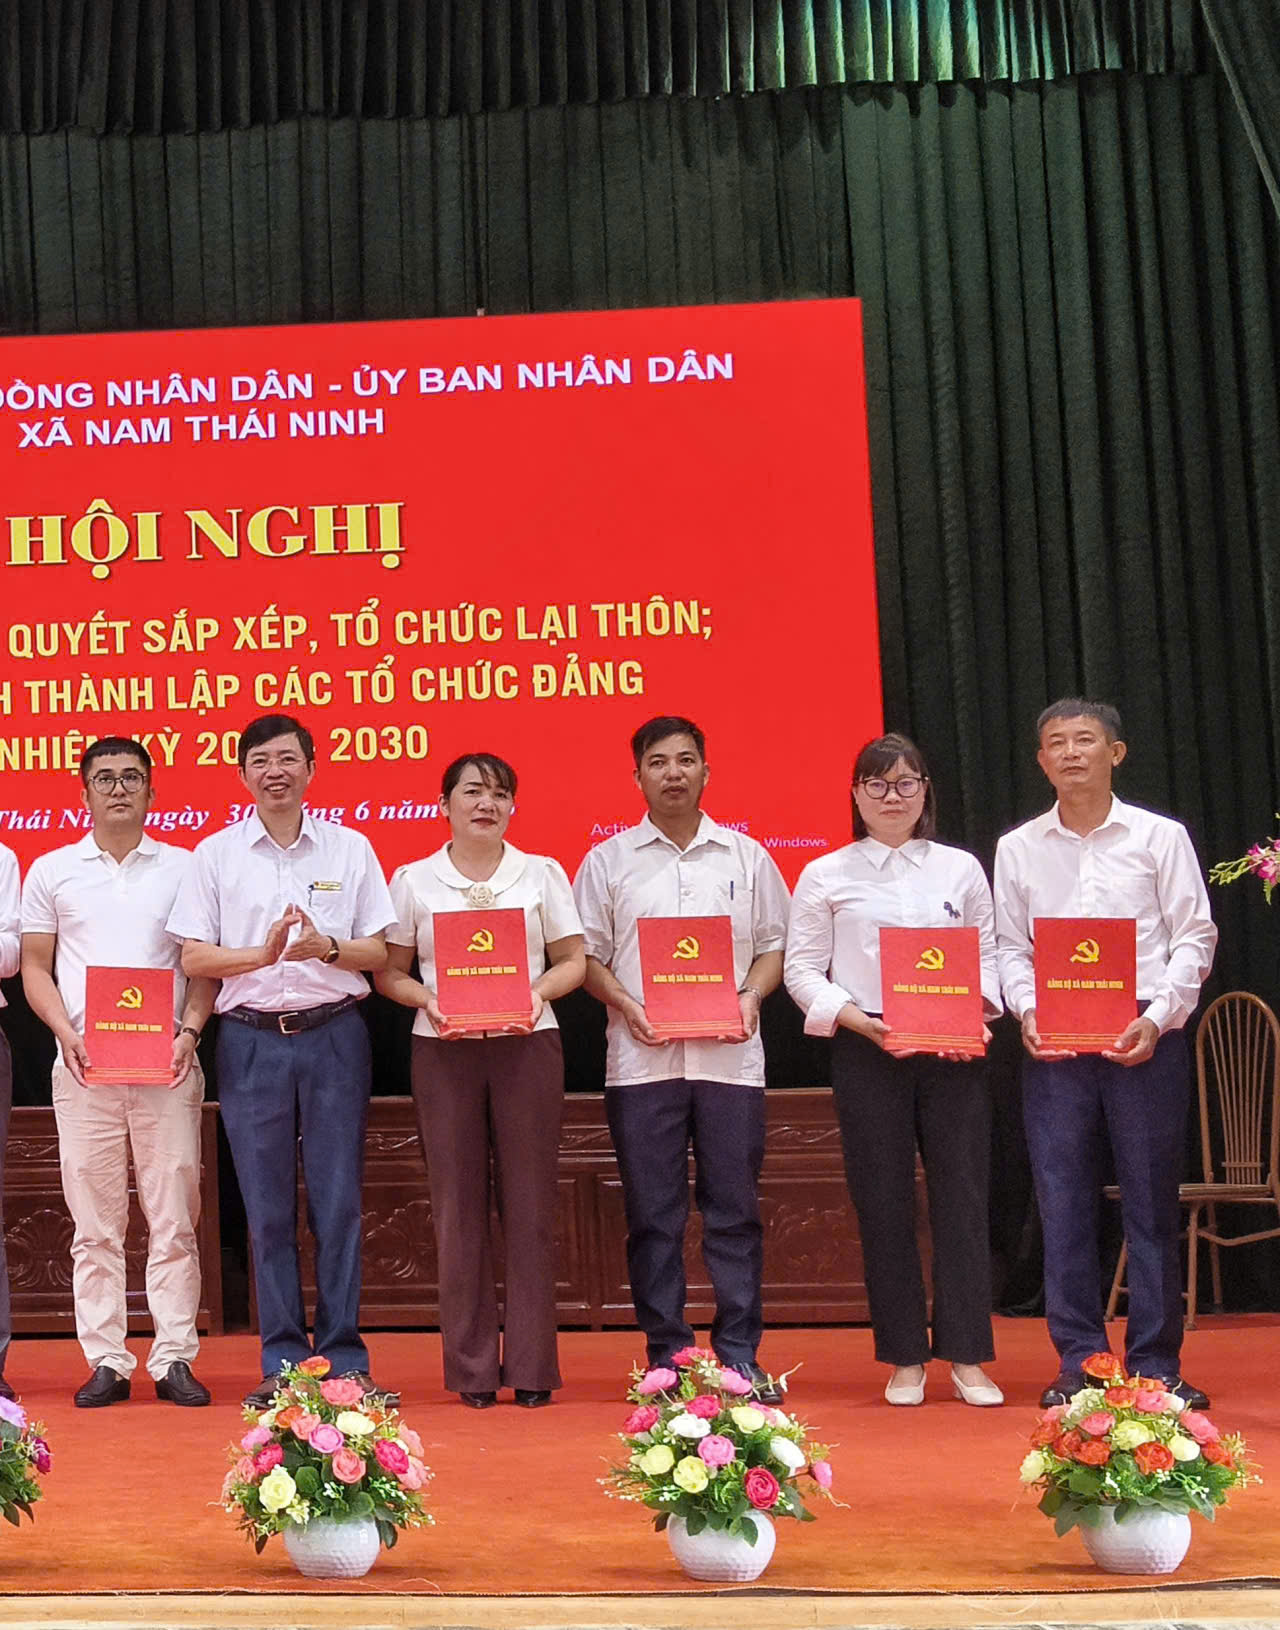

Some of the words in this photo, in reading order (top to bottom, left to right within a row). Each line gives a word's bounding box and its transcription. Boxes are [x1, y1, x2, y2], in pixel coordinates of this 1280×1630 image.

[107, 373, 215, 406] NHÂN
[232, 369, 312, 400] DÂN
[354, 365, 406, 395] ỦY
[420, 365, 501, 393] BAN
[518, 355, 630, 388] NHÂN
[648, 350, 732, 382] DÂN
[19, 416, 72, 447] XÃ
[86, 417, 170, 445] NAM
[184, 408, 275, 440] THÁI
[290, 409, 383, 437] NINH
[5, 499, 162, 578] HỘI
[184, 502, 405, 568] NGHỊ
[9, 610, 130, 658] QUYẾT
[143, 609, 219, 653] SẮP
[233, 604, 317, 654] XẾP,
[330, 598, 379, 646] TỔ
[395, 603, 502, 644] CHỨC
[517, 605, 577, 646] LẠI
[591, 595, 711, 639] THÔN;
[24, 673, 153, 713] THÀNH
[167, 669, 239, 715] LẬP
[255, 666, 331, 706] CÁC
[346, 655, 394, 703] TỔ
[412, 660, 518, 701] CHỨC
[532, 653, 643, 697] ĐẢNG
[330, 725, 427, 761] 2030
[144, 805, 210, 832] ngày
[354, 801, 370, 821] 6
[379, 802, 438, 820] năm
[764, 837, 828, 848] Windows
